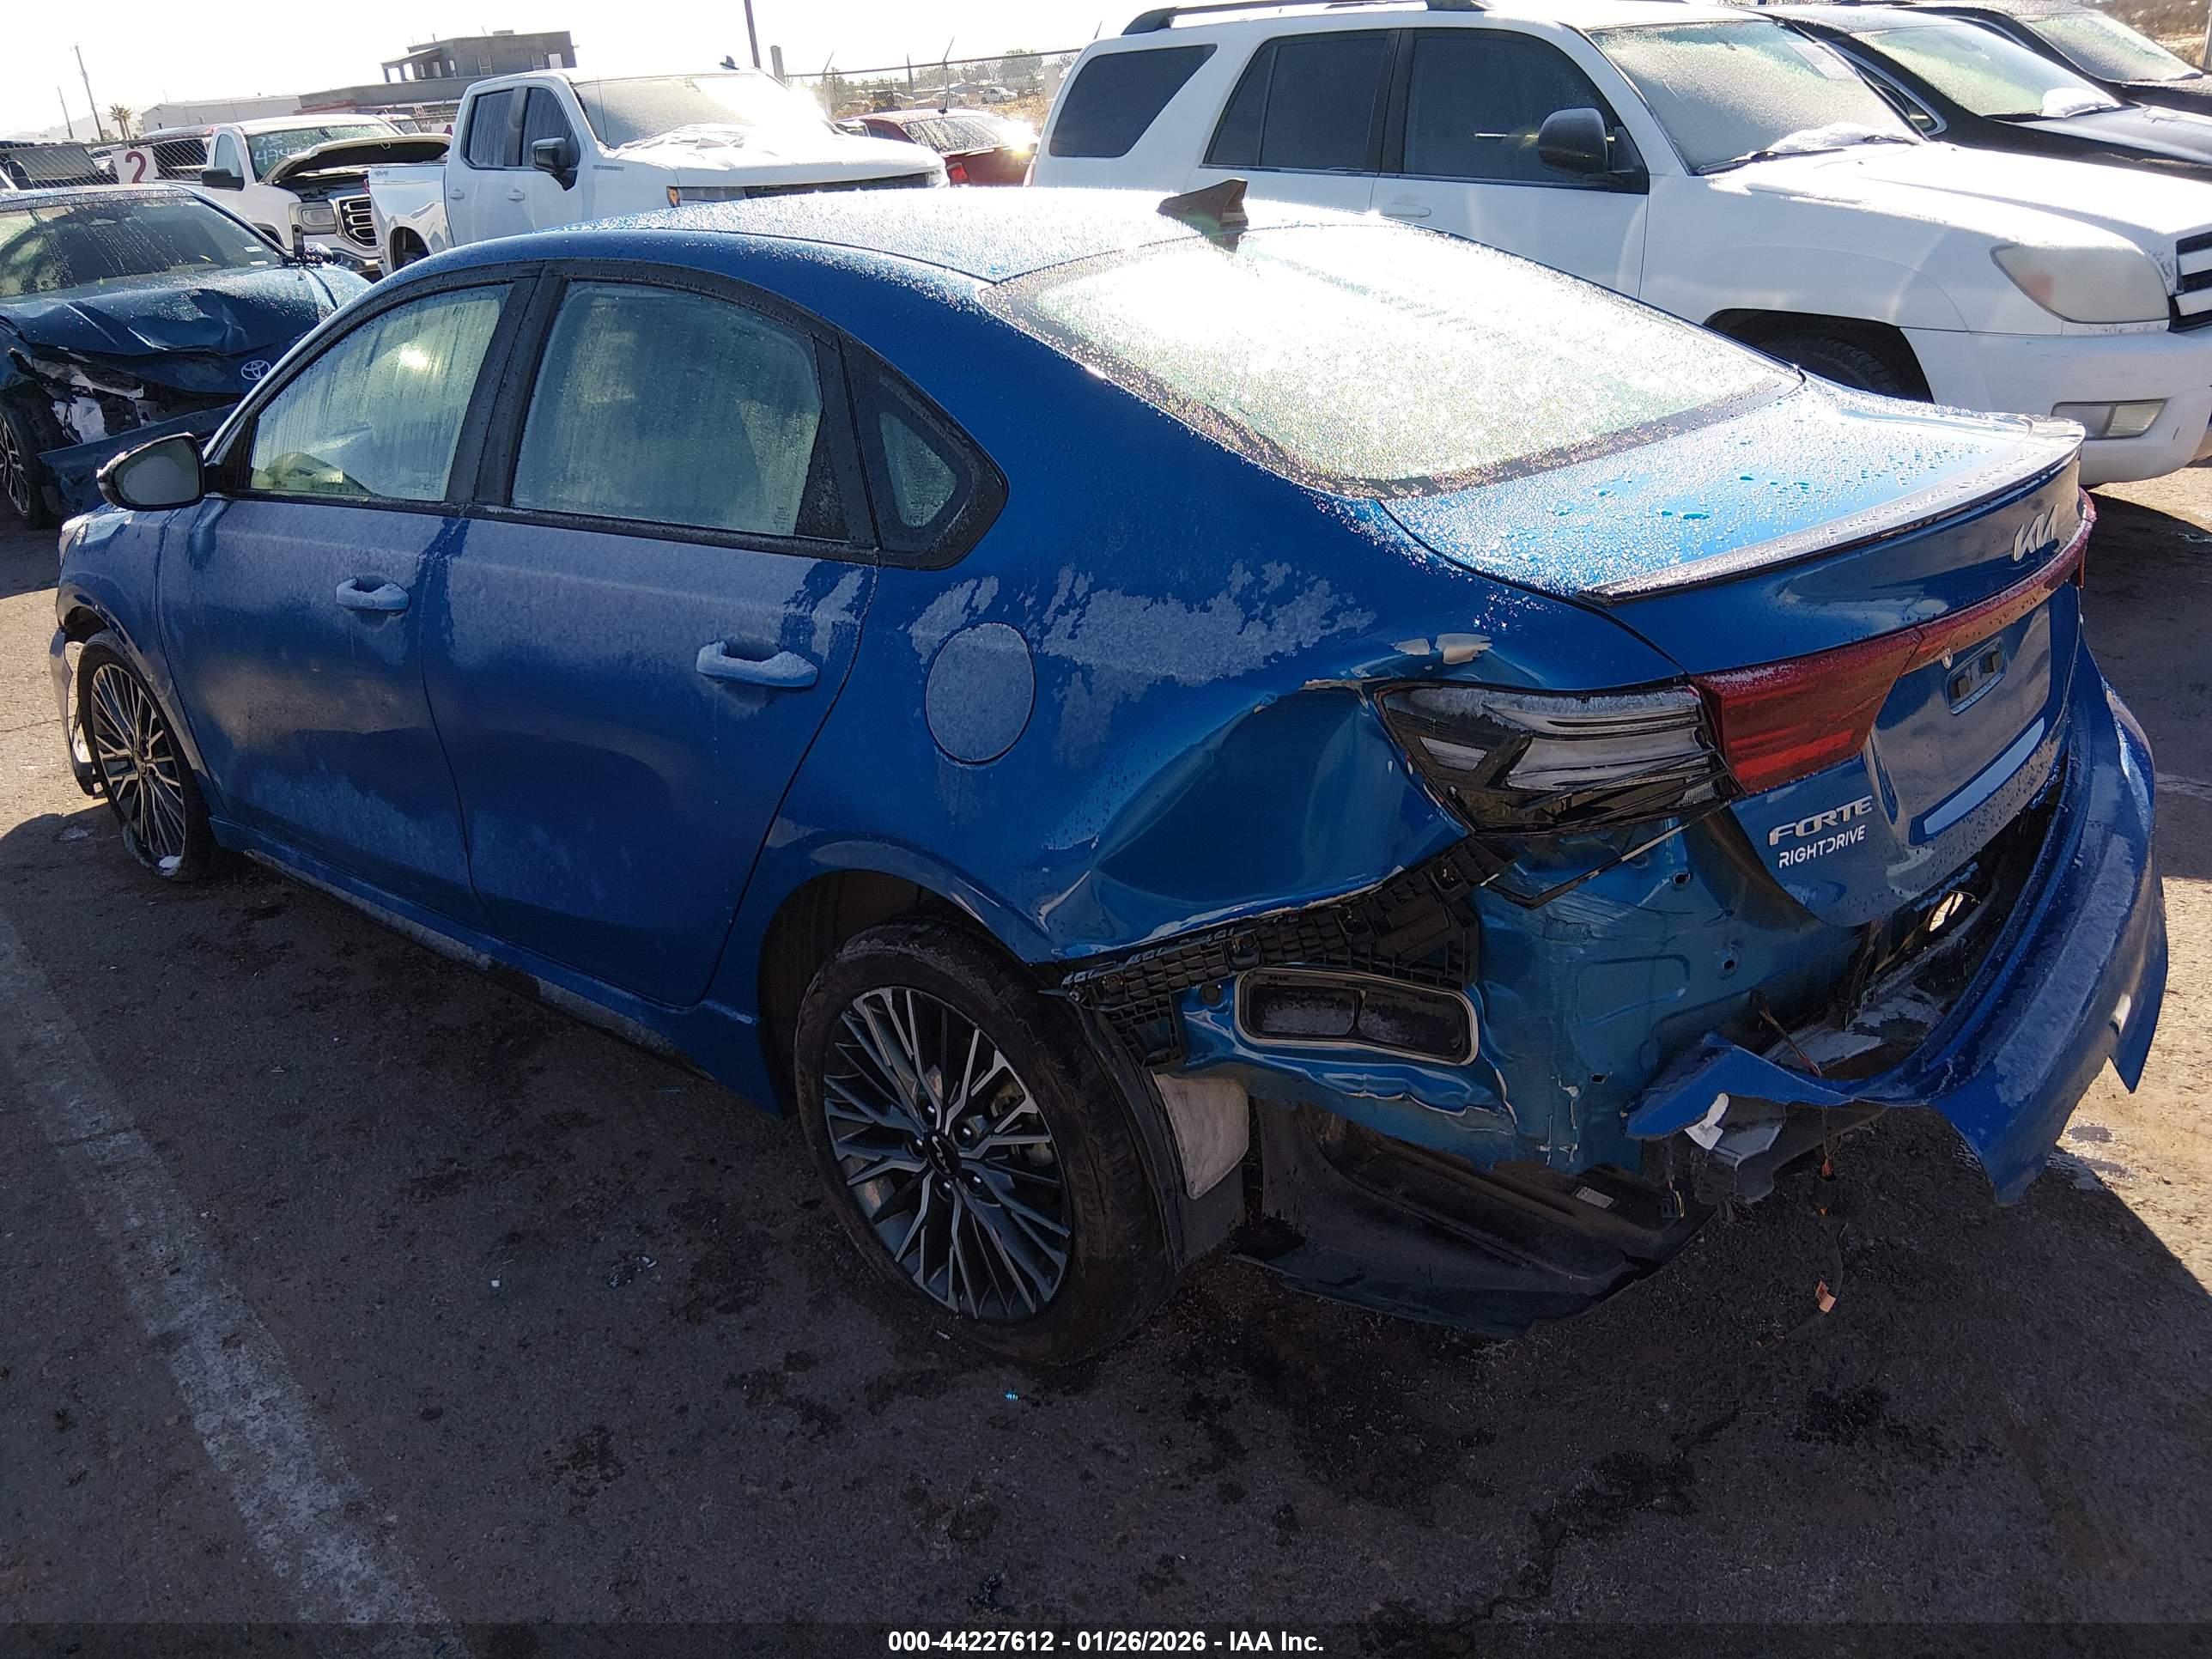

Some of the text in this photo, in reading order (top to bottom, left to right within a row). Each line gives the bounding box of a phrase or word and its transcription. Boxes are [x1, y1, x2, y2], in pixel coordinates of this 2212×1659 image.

[125, 150, 147, 184] 2
[2013, 503, 2059, 562] KIA
[1768, 794, 1873, 846] FORTE
[1778, 824, 1866, 868] RIGHTDRIVE
